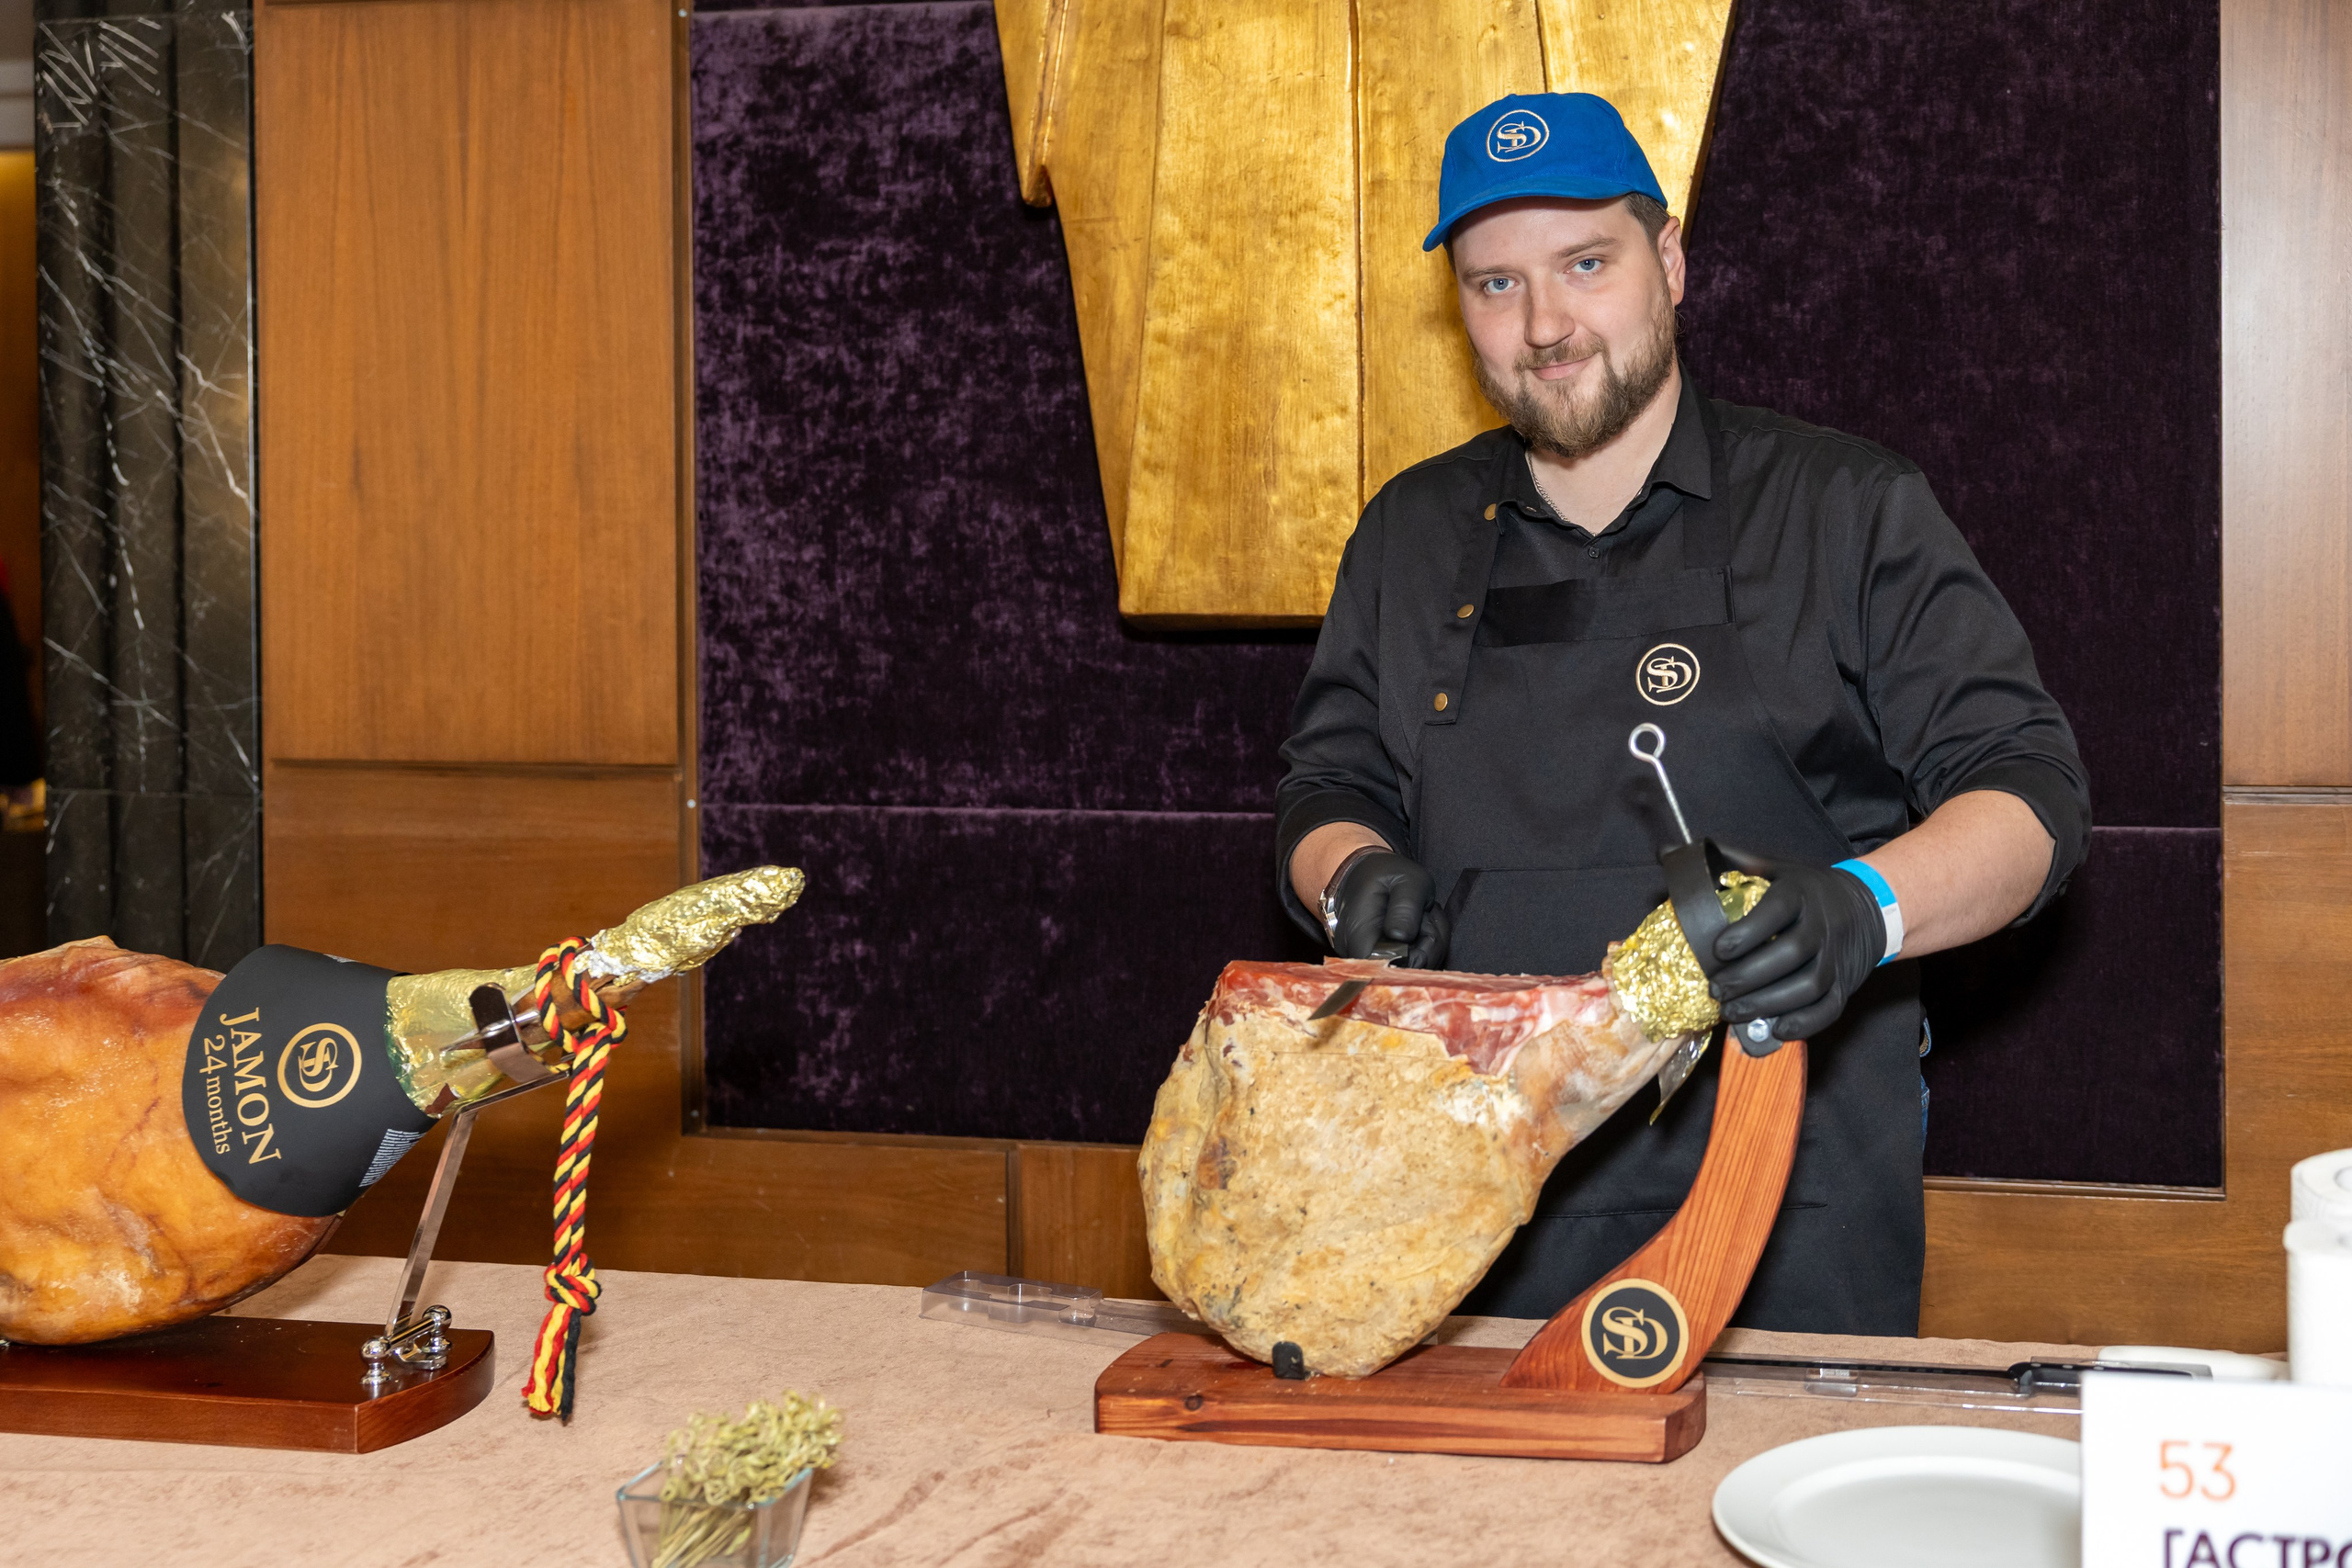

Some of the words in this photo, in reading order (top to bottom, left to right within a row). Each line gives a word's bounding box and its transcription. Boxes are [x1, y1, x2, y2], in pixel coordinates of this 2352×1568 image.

[198, 1034, 228, 1075] 24
[220, 1007, 282, 1165] JAMON
[206, 1076, 232, 1155] months
[2159, 1439, 2237, 1502] 53
[2164, 1528, 2352, 1568] ГАСТР
